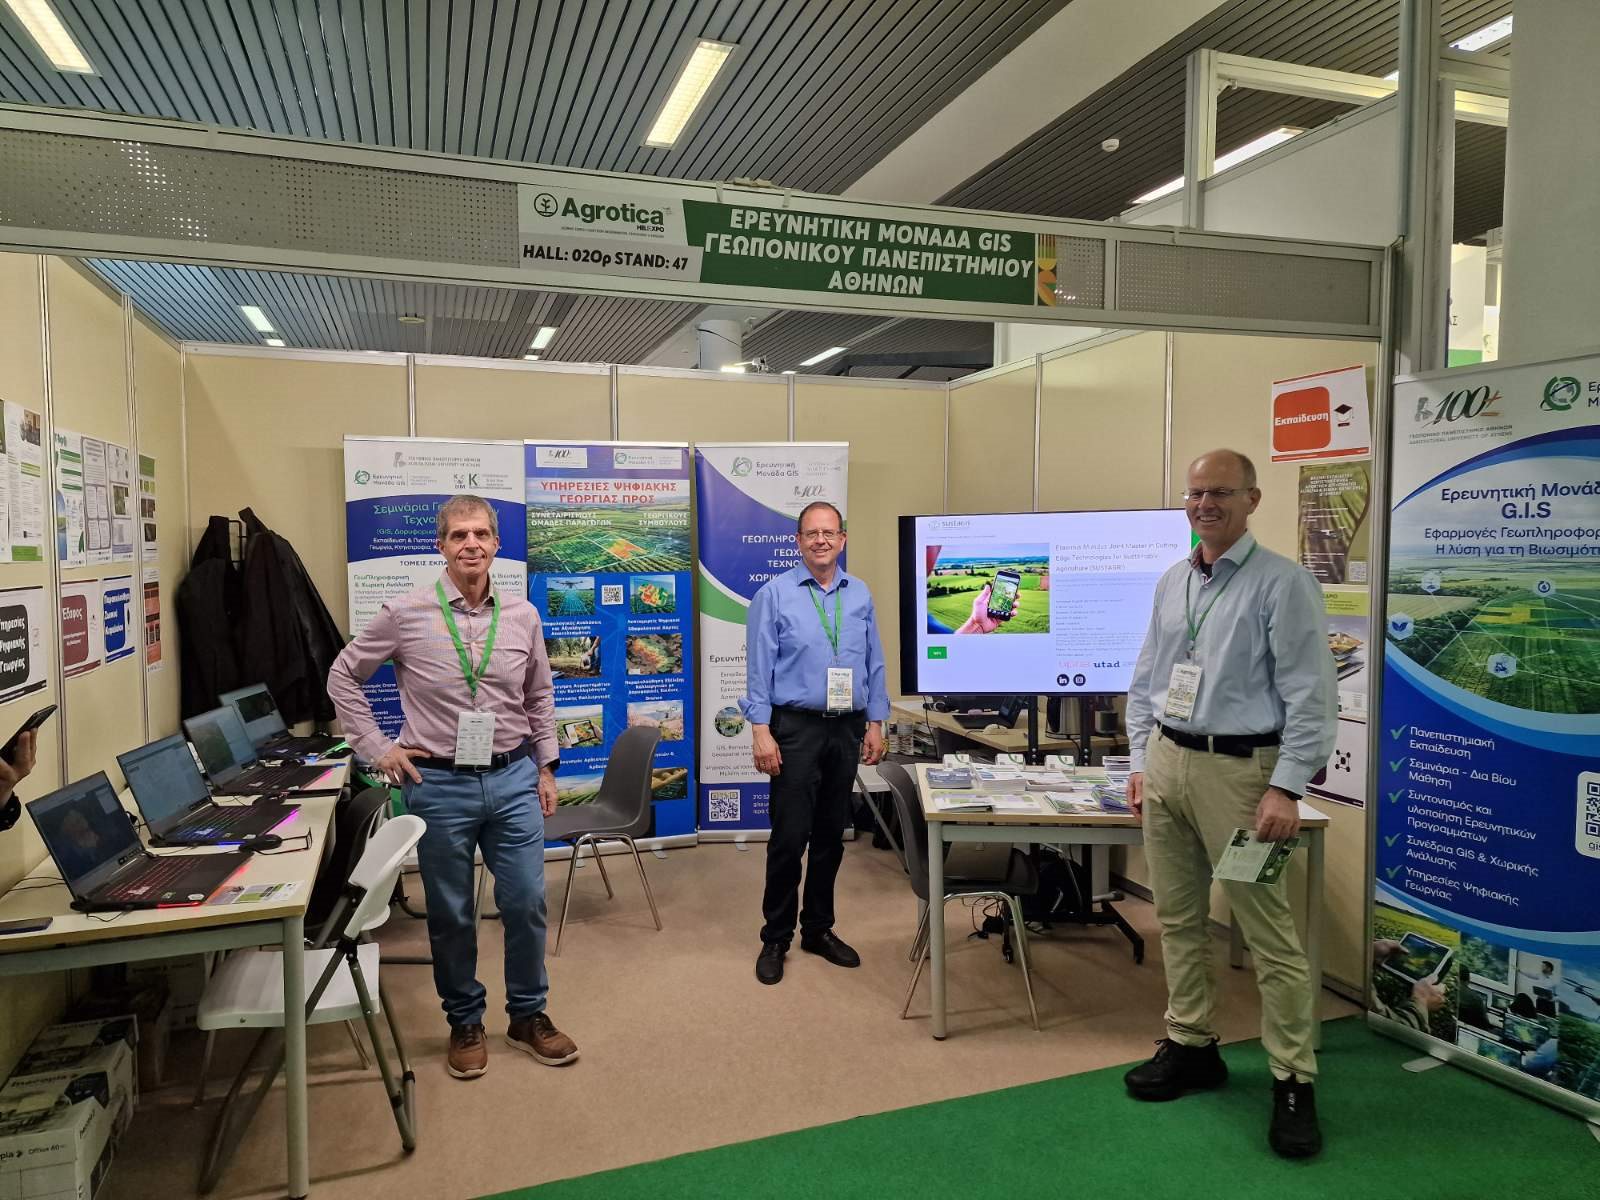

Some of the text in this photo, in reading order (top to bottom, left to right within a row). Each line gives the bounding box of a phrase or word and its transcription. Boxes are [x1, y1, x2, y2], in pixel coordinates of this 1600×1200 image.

[561, 197, 664, 225] Agrotica
[730, 208, 1012, 252] ΕΡΕΥΝΗΤΙΚΗ ΜΟΝΑΔΑ GIS
[523, 245, 568, 261] HALL:
[615, 252, 670, 269] STAND:
[672, 257, 689, 271] 47
[705, 233, 1034, 278] ΓΕΩΠΟΝΙΚΟΥ ΠΑΝΕΠΙΣΤΗΜΙΟΥ
[828, 270, 924, 295] ΑΘΗΝΩΝ
[541, 481, 677, 492] ΥΠΗΡΕΣΙΕΣ ΨΗΦΙΑΚΗΣ
[560, 494, 655, 504] ΓΕΩΡΓΙΑΣ ΠΡΟΣ
[1441, 483, 1536, 503] Ερευνητική
[373, 502, 429, 515] Σεμινάρια
[1501, 502, 1551, 519] G.I.S
[1424, 528, 1497, 541] Εφαρμογές
[1448, 543, 1481, 557] λύση
[1484, 545, 1505, 557] για
[1508, 546, 1525, 558] τη
[1093, 660, 1120, 668] utad
[1409, 739, 1471, 760] Εκπαίδευση
[1410, 726, 1495, 751] Πανεπιστημιακή
[1409, 758, 1460, 775] Σεμινάρια
[1470, 769, 1489, 781] Δια
[1491, 773, 1517, 786] Βίου
[1408, 789, 1492, 815] Συντονισμός και
[1407, 805, 1536, 840] υλοποίηση Ερευνητικών
[1407, 816, 1488, 843] Προγραμμάτων
[1406, 835, 1539, 877] Συνέδρια GIS & Χωρικής
[1406, 848, 1457, 870] Ανάλυσης
[1405, 866, 1520, 906] Υπηρεσίες Ψηφιακής
[1405, 880, 1453, 901] Γεωργίας
